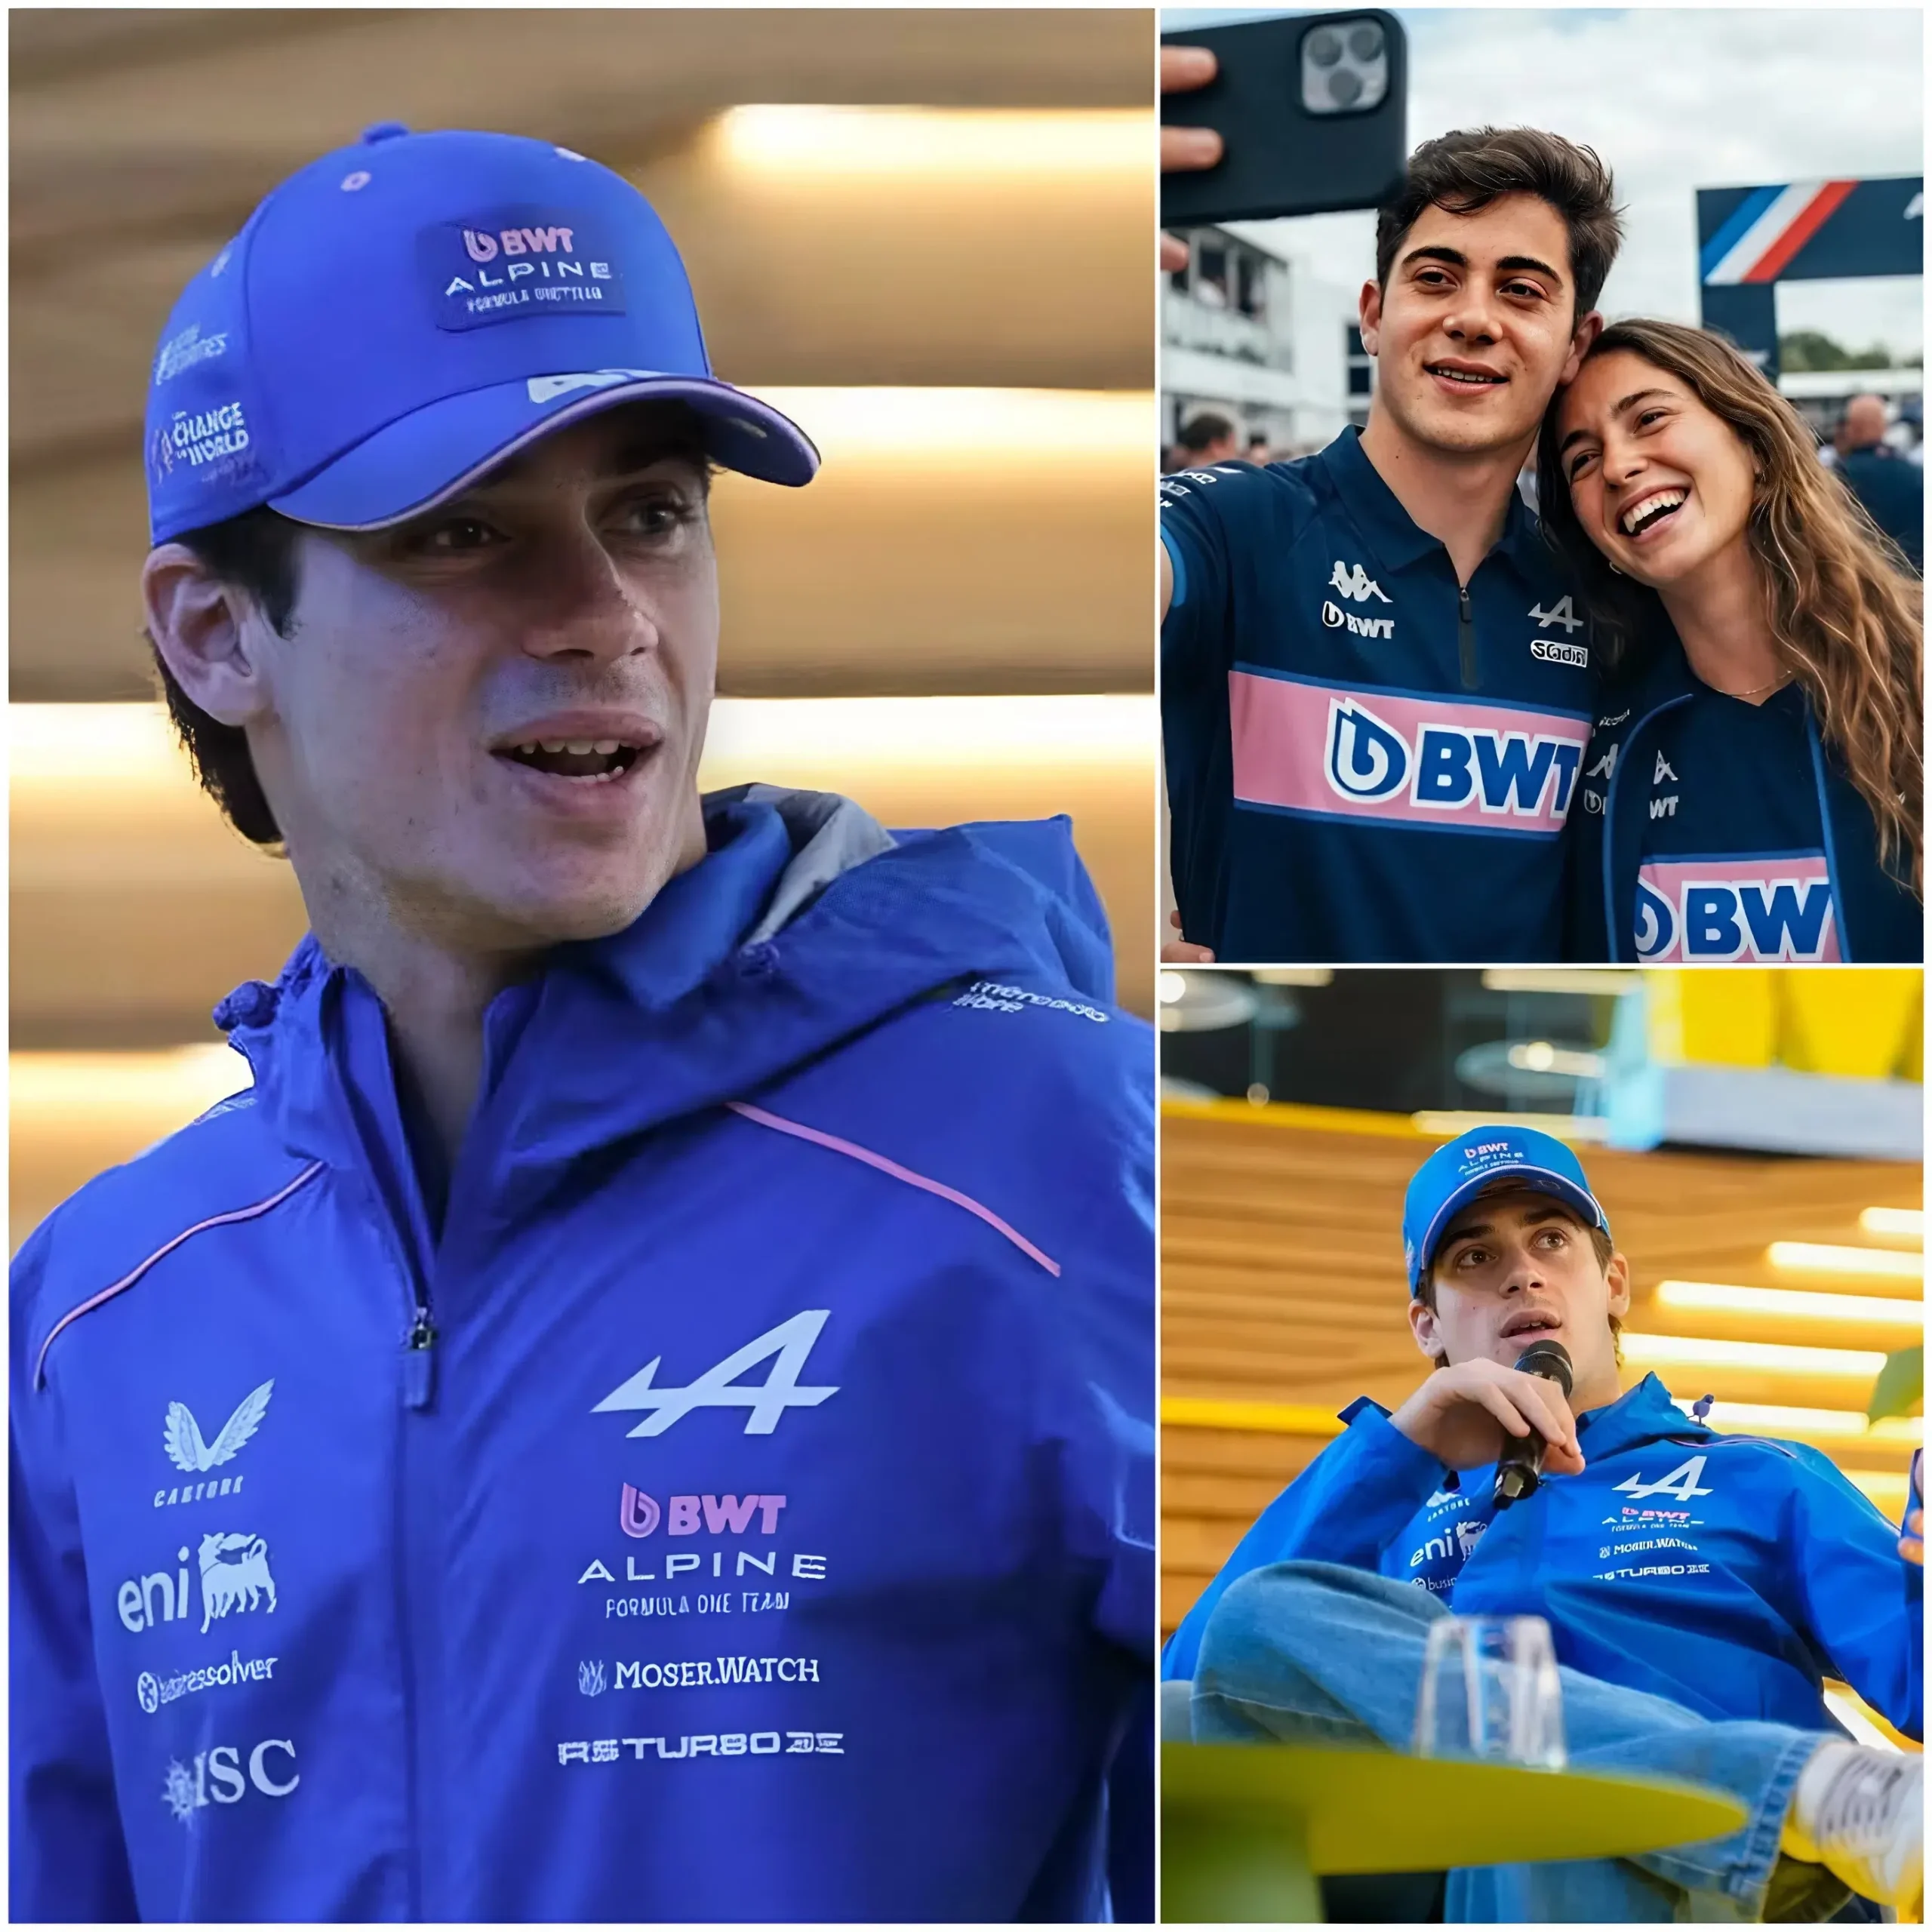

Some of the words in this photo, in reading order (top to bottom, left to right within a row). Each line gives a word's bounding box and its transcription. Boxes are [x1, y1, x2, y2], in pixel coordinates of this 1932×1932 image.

[500, 226, 574, 257] BWT
[445, 261, 612, 297] ALPINE
[1410, 722, 1585, 820] BWT
[1650, 795, 1679, 820] WT
[1681, 876, 1835, 962] BW
[669, 1494, 786, 1536] BWT
[1410, 1527, 1454, 1567] eni
[577, 1551, 827, 1584] ALPINE
[118, 1546, 189, 1632] eni
[614, 1657, 820, 1690] MOSER.WATCH
